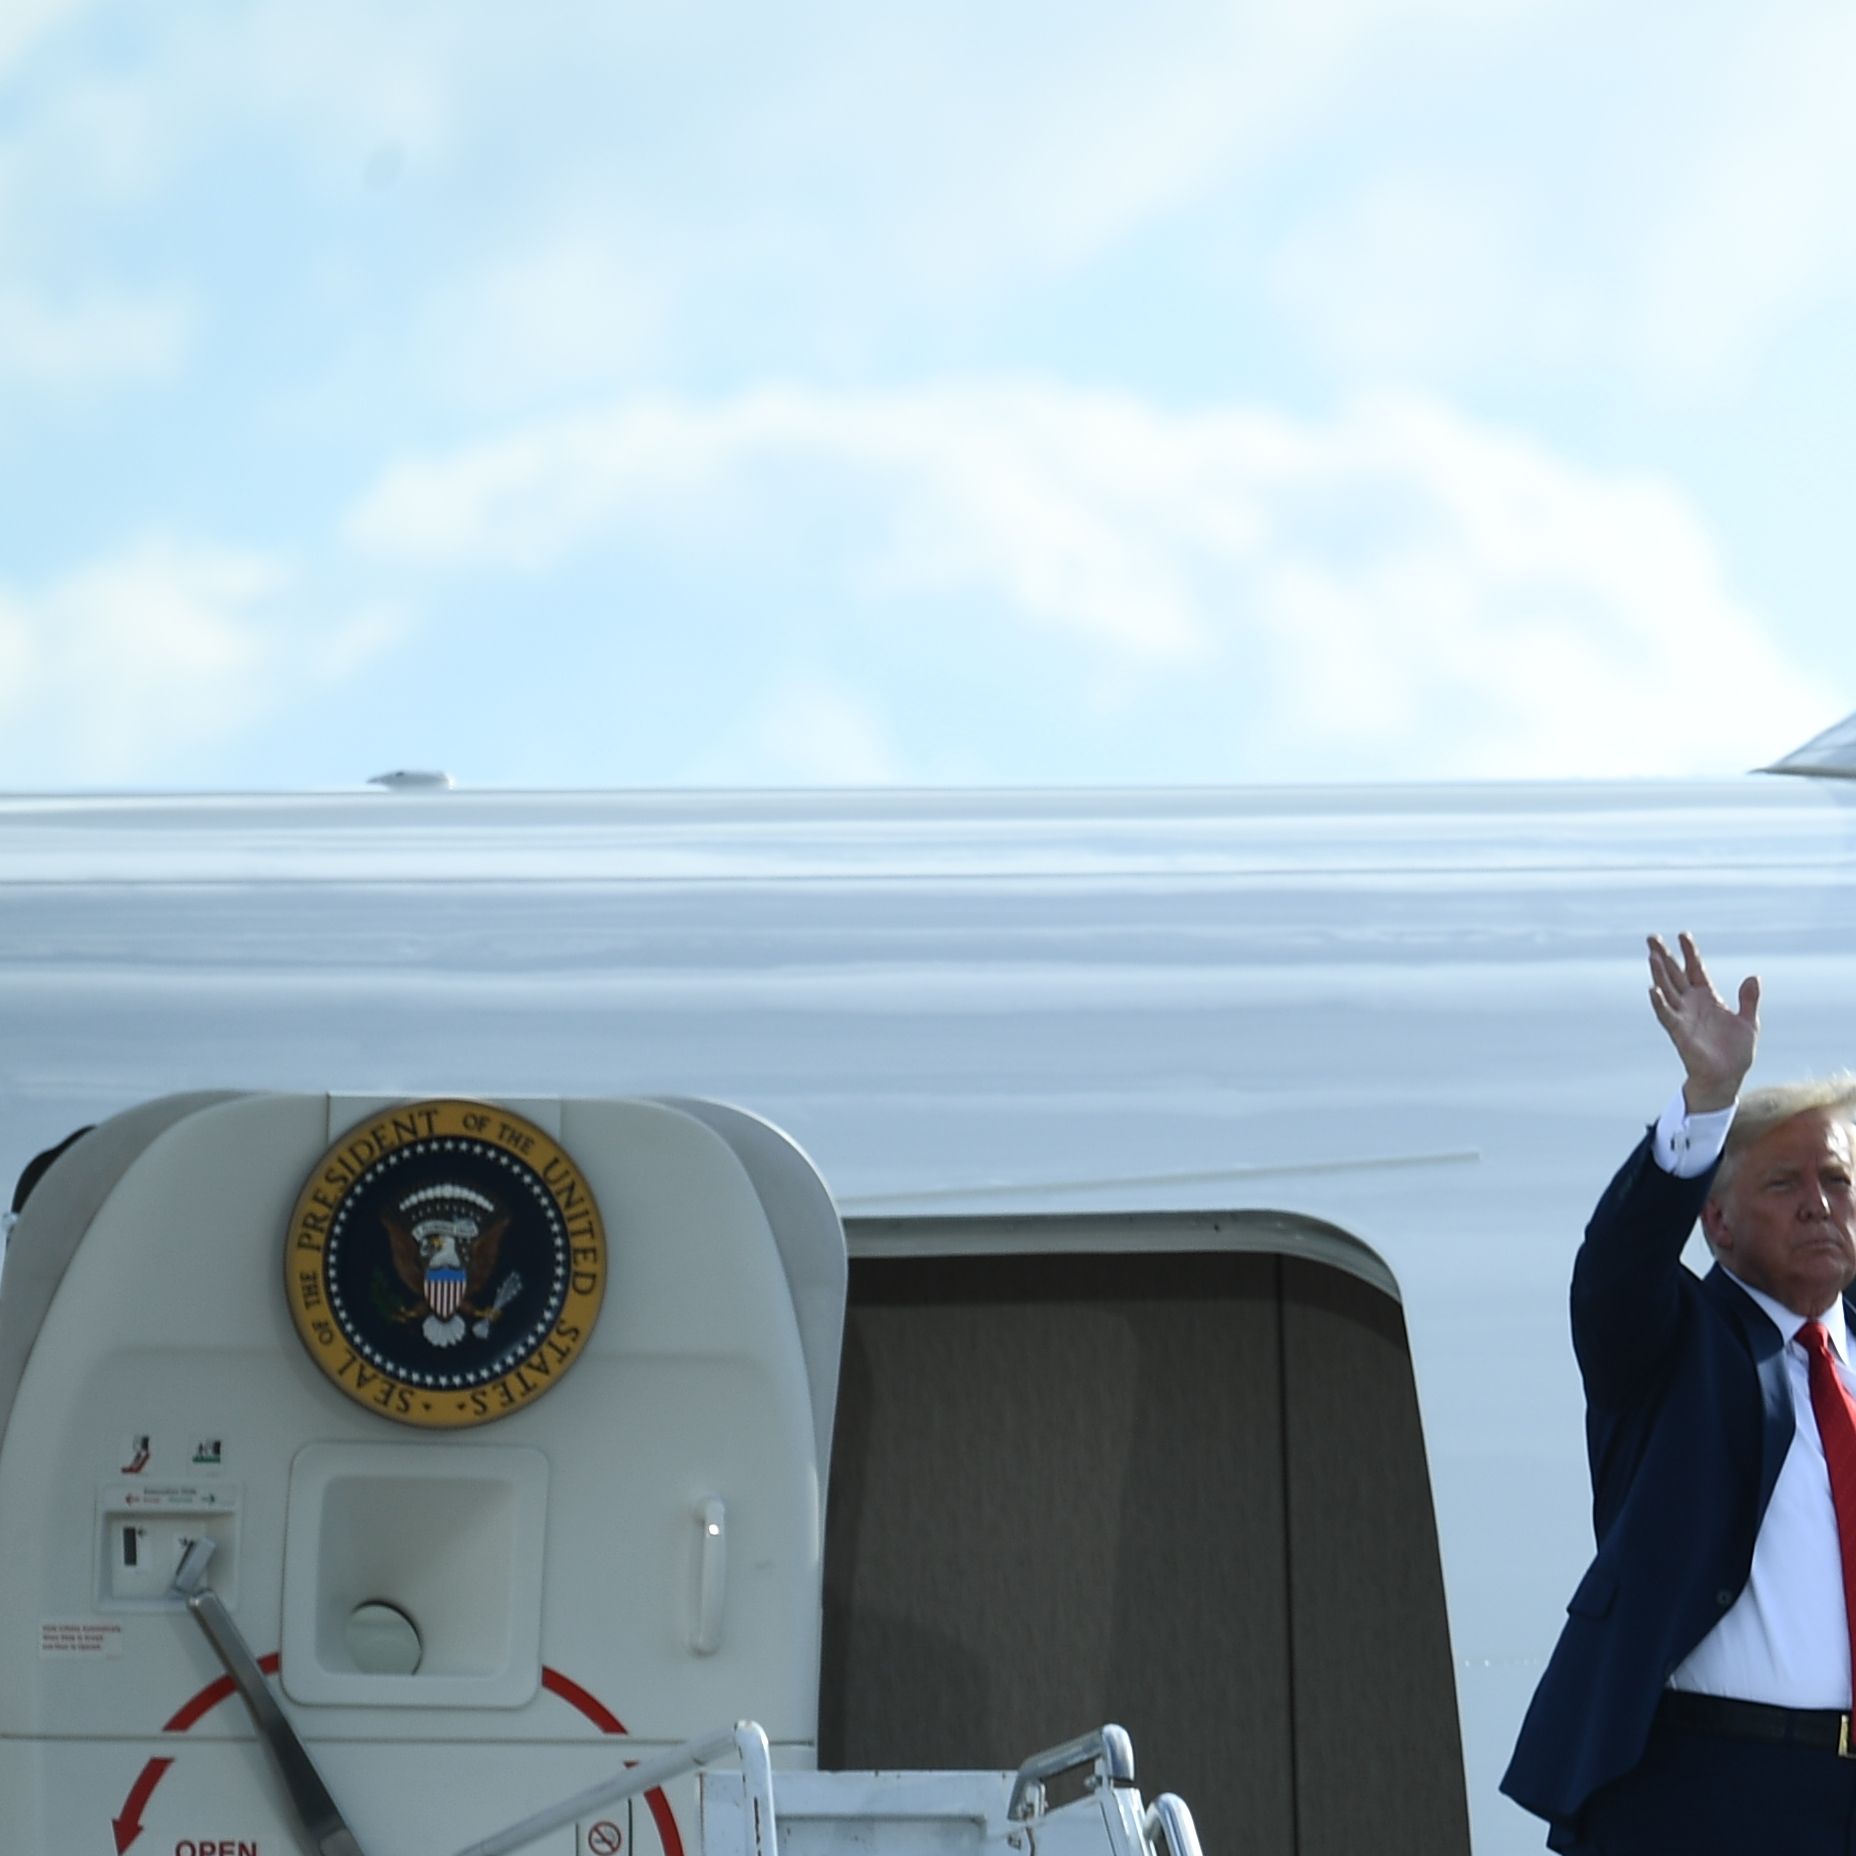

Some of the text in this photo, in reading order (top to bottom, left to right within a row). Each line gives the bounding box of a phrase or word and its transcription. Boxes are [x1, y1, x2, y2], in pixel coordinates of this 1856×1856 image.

[297, 1109, 598, 1417] SEAL OF THE PRESIDENT OF THE UNITED STATES
